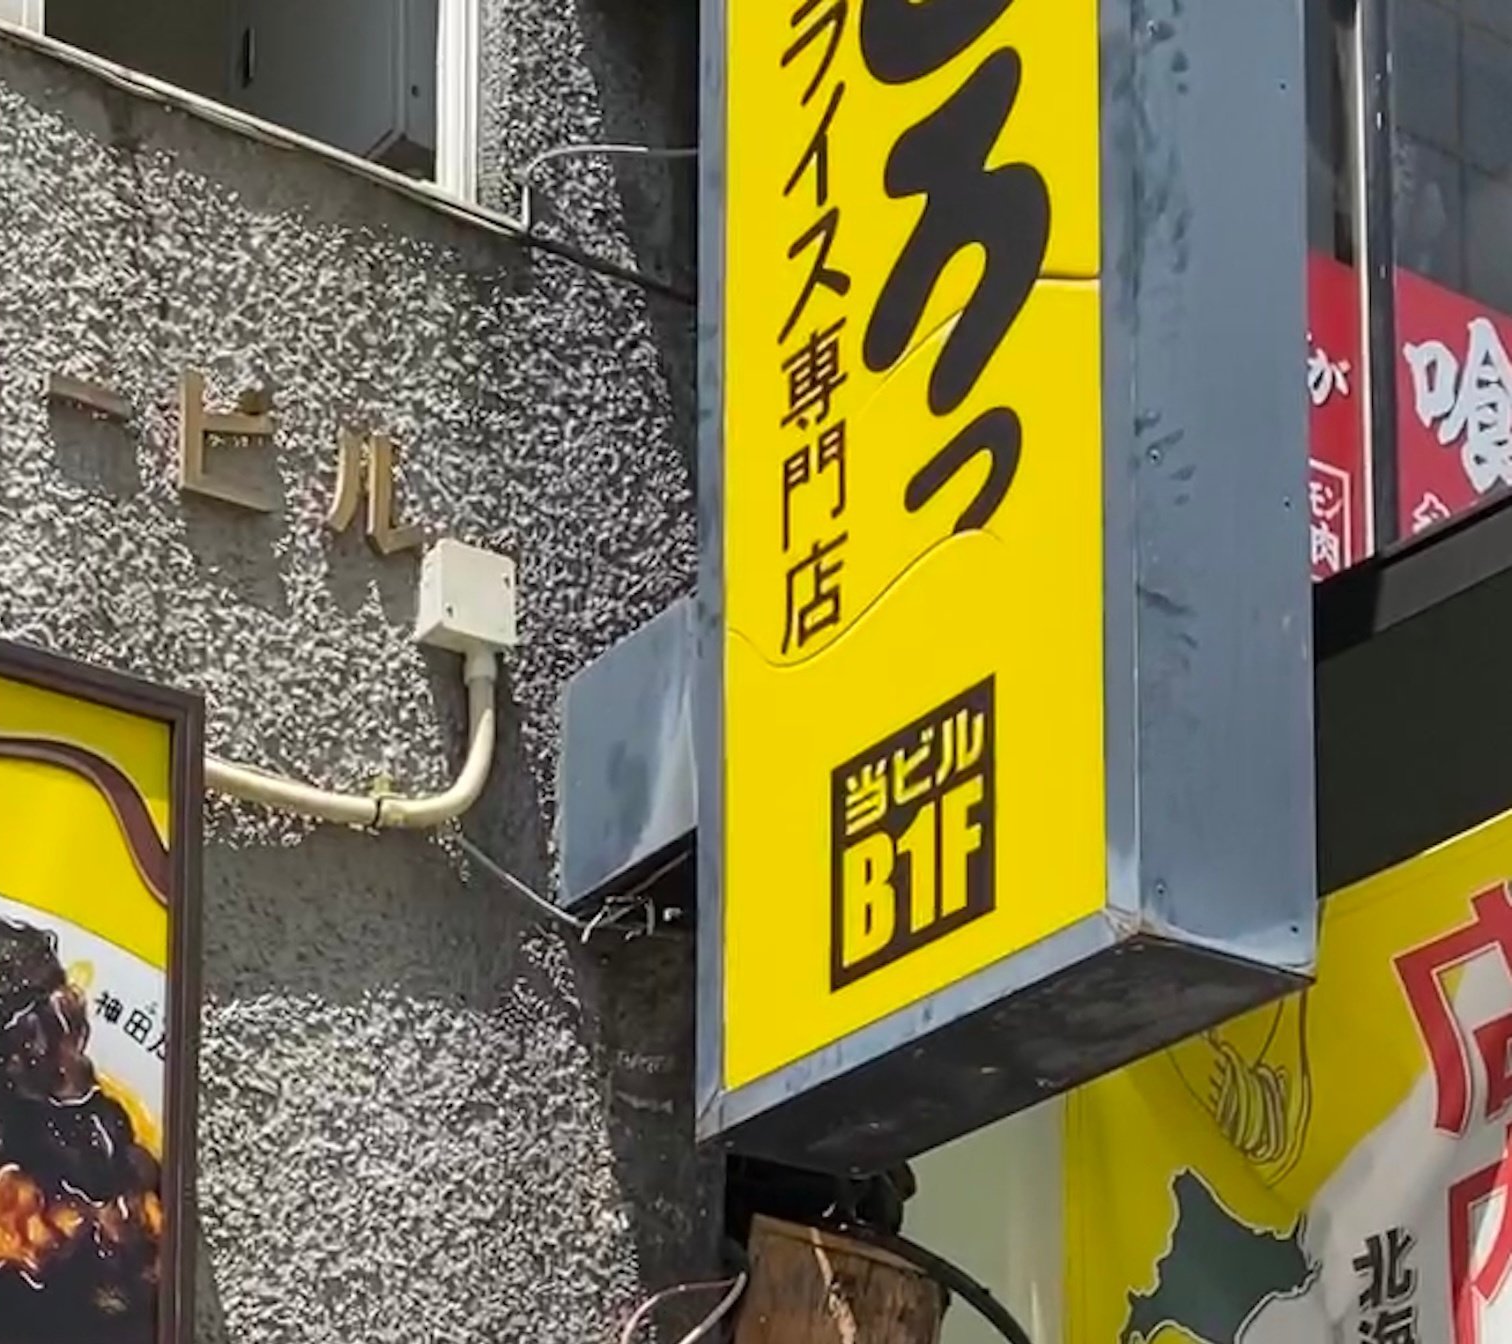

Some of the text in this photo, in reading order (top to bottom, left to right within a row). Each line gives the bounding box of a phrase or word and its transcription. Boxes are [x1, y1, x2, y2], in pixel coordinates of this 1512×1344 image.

[780, 0, 850, 654] ライス専門店
[844, 708, 985, 837] 当ビル
[843, 774, 985, 969] B1F
